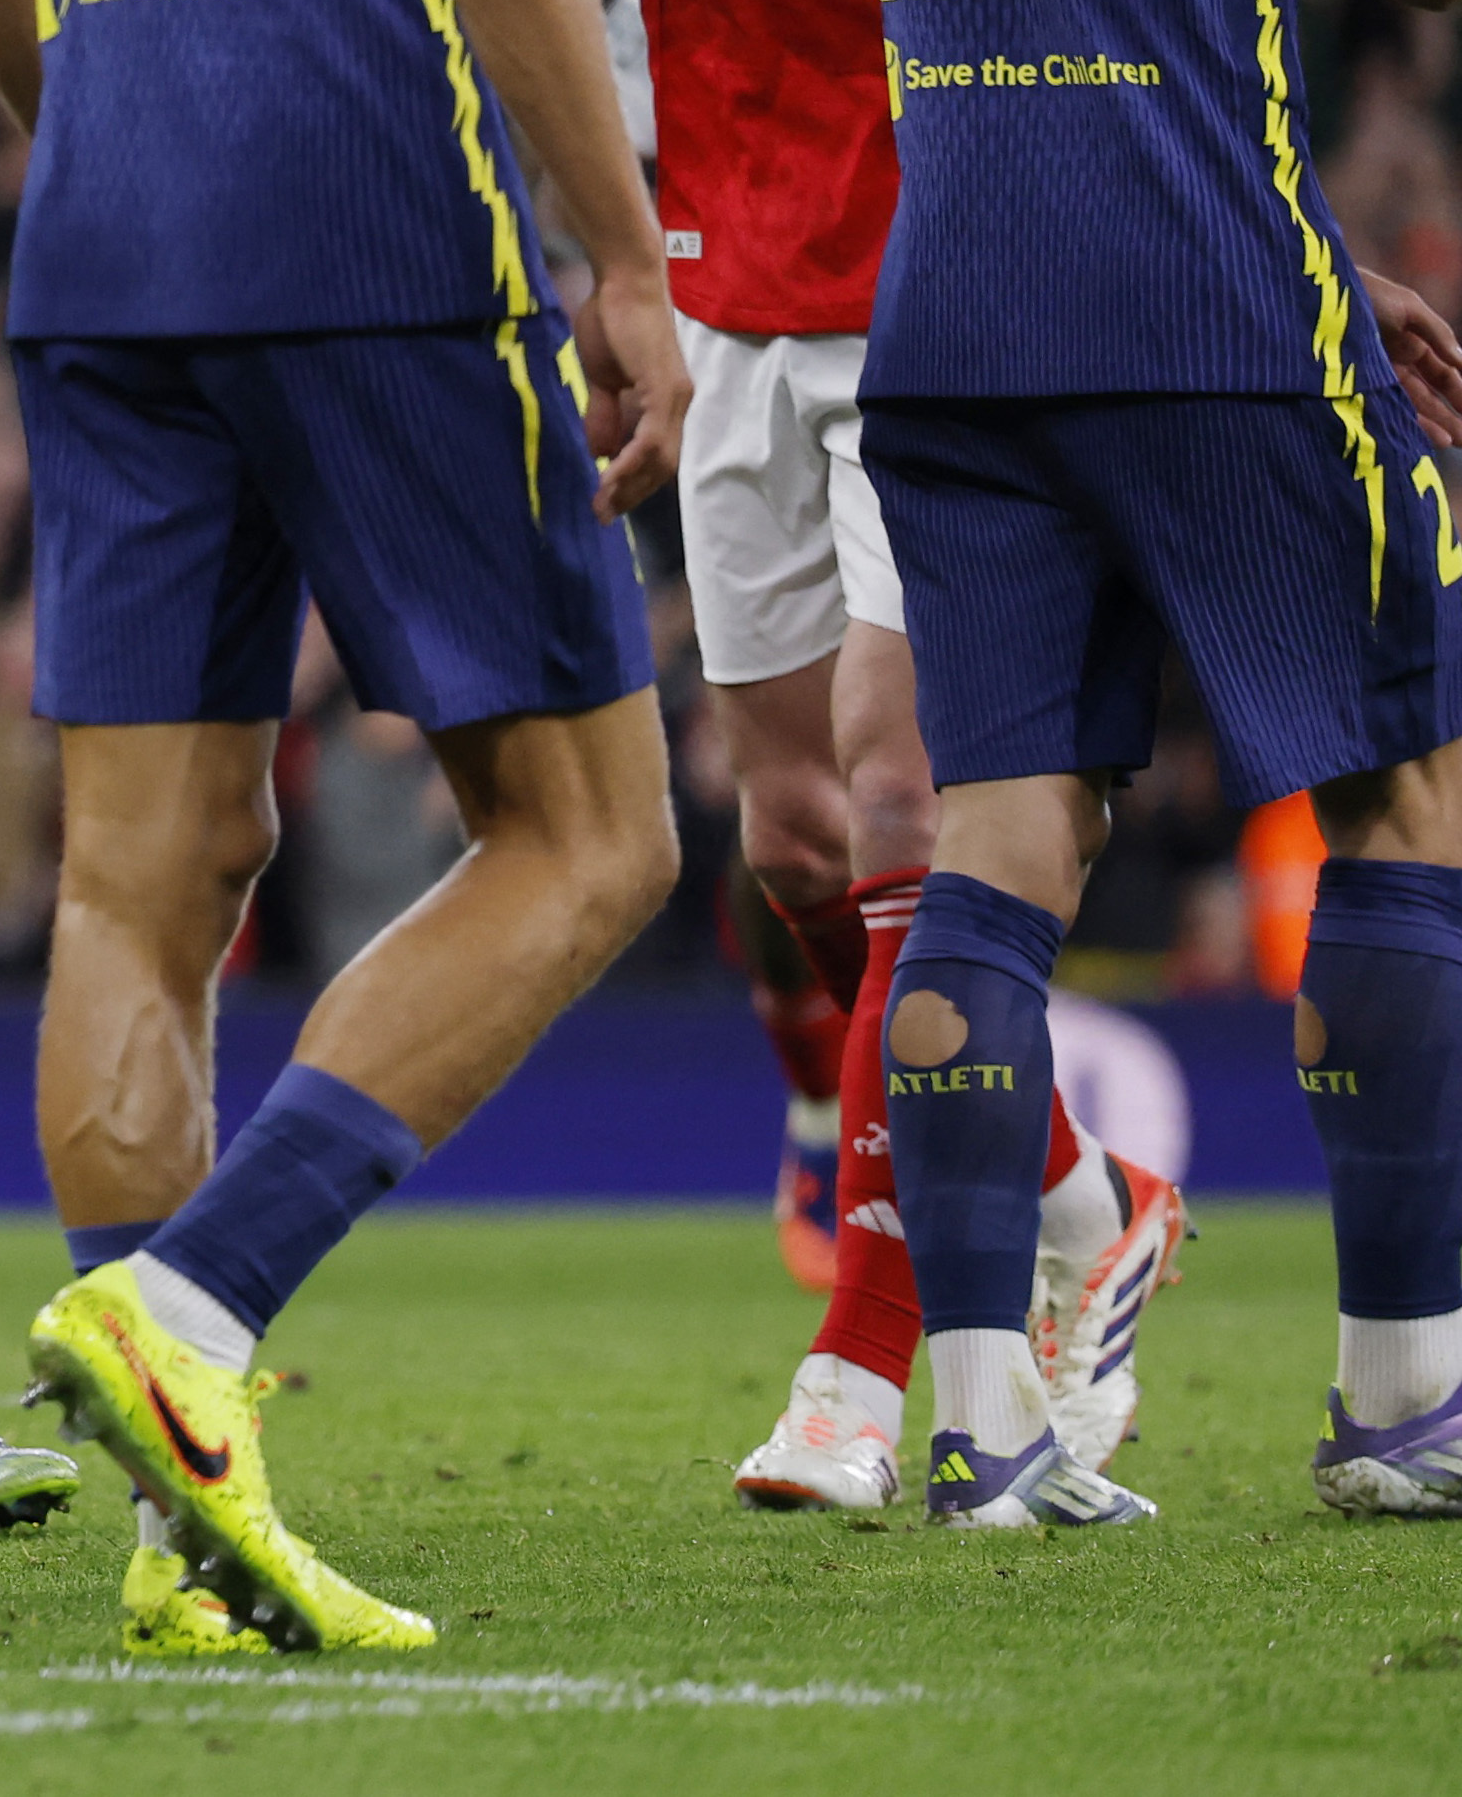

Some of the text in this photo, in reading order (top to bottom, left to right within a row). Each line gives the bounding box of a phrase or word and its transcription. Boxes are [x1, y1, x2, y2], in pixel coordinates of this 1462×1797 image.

[905, 53, 1161, 90] Save the Children
[888, 1064, 1014, 1097] ATLETI
[1296, 1067, 1359, 1096] LETI
